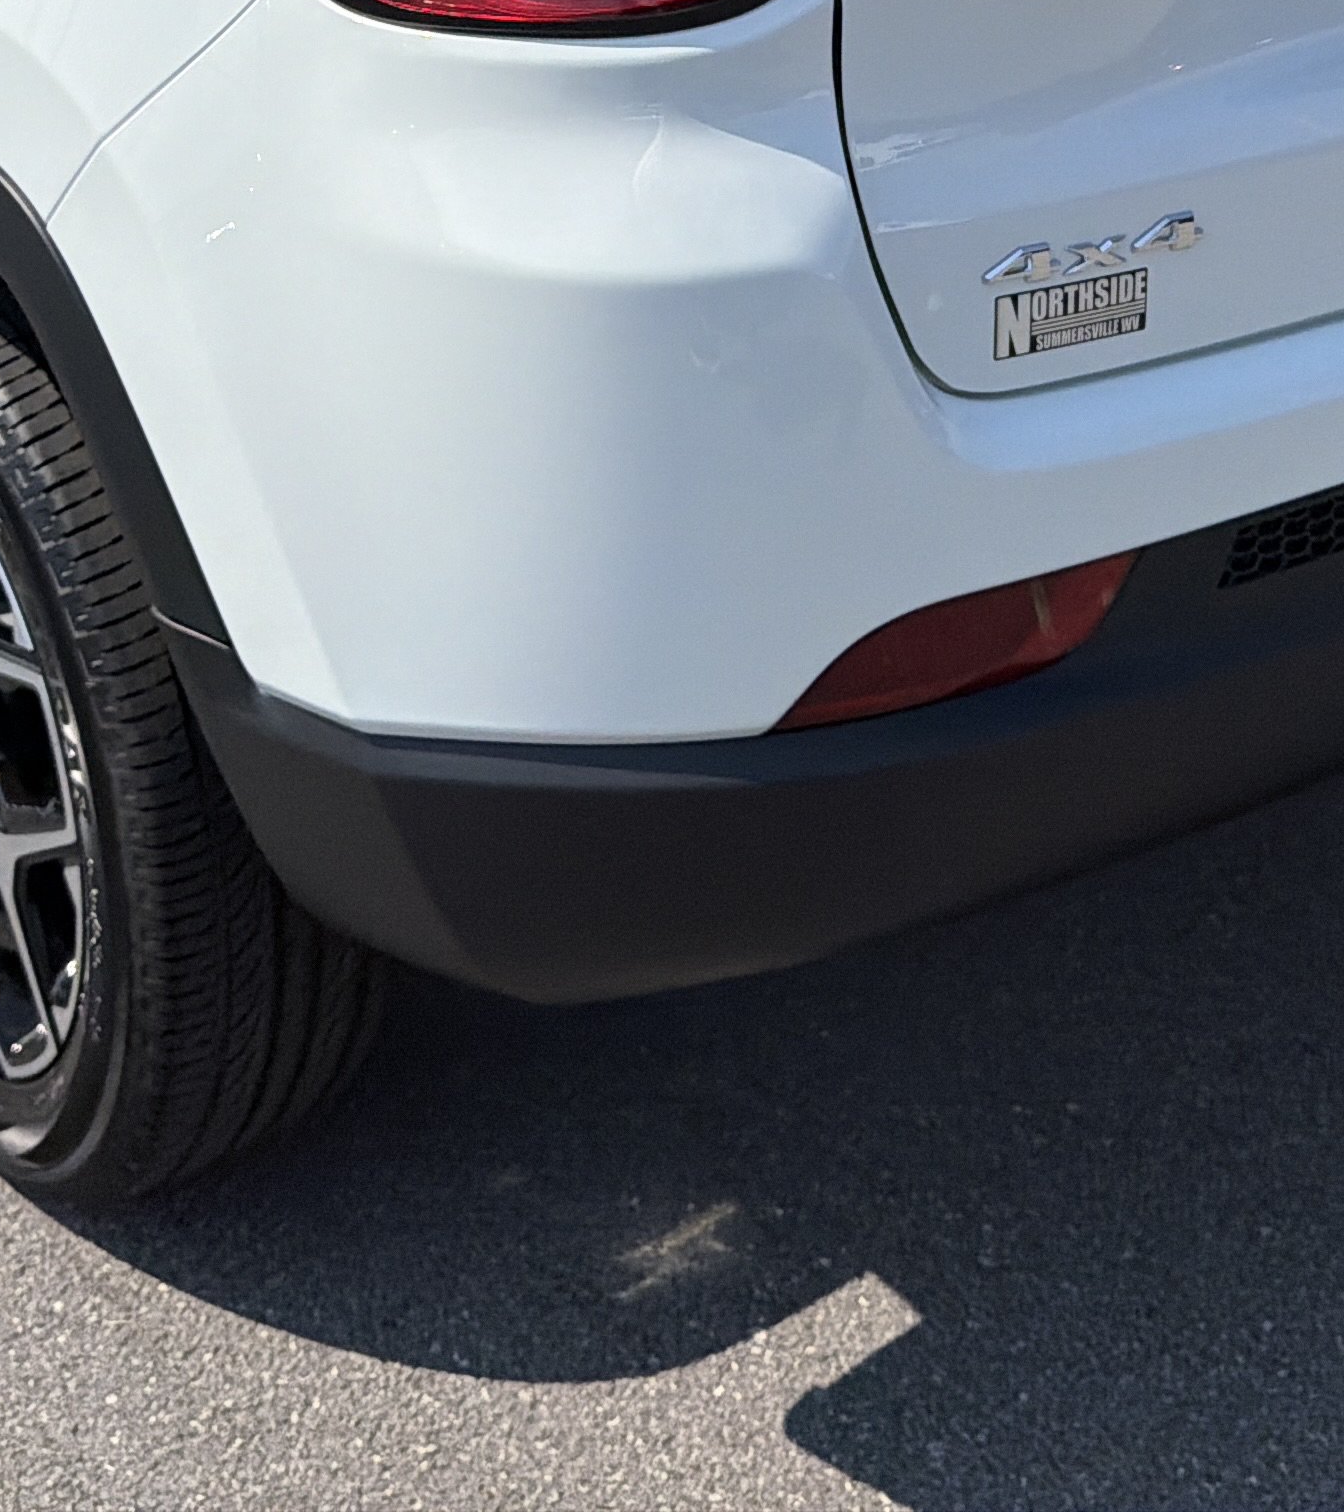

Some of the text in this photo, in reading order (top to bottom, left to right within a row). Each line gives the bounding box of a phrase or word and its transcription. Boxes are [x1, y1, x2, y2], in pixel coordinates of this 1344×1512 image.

[996, 271, 1147, 359] NORTHSIDE
[1036, 315, 1141, 351] SUMMERSVILLE WV
